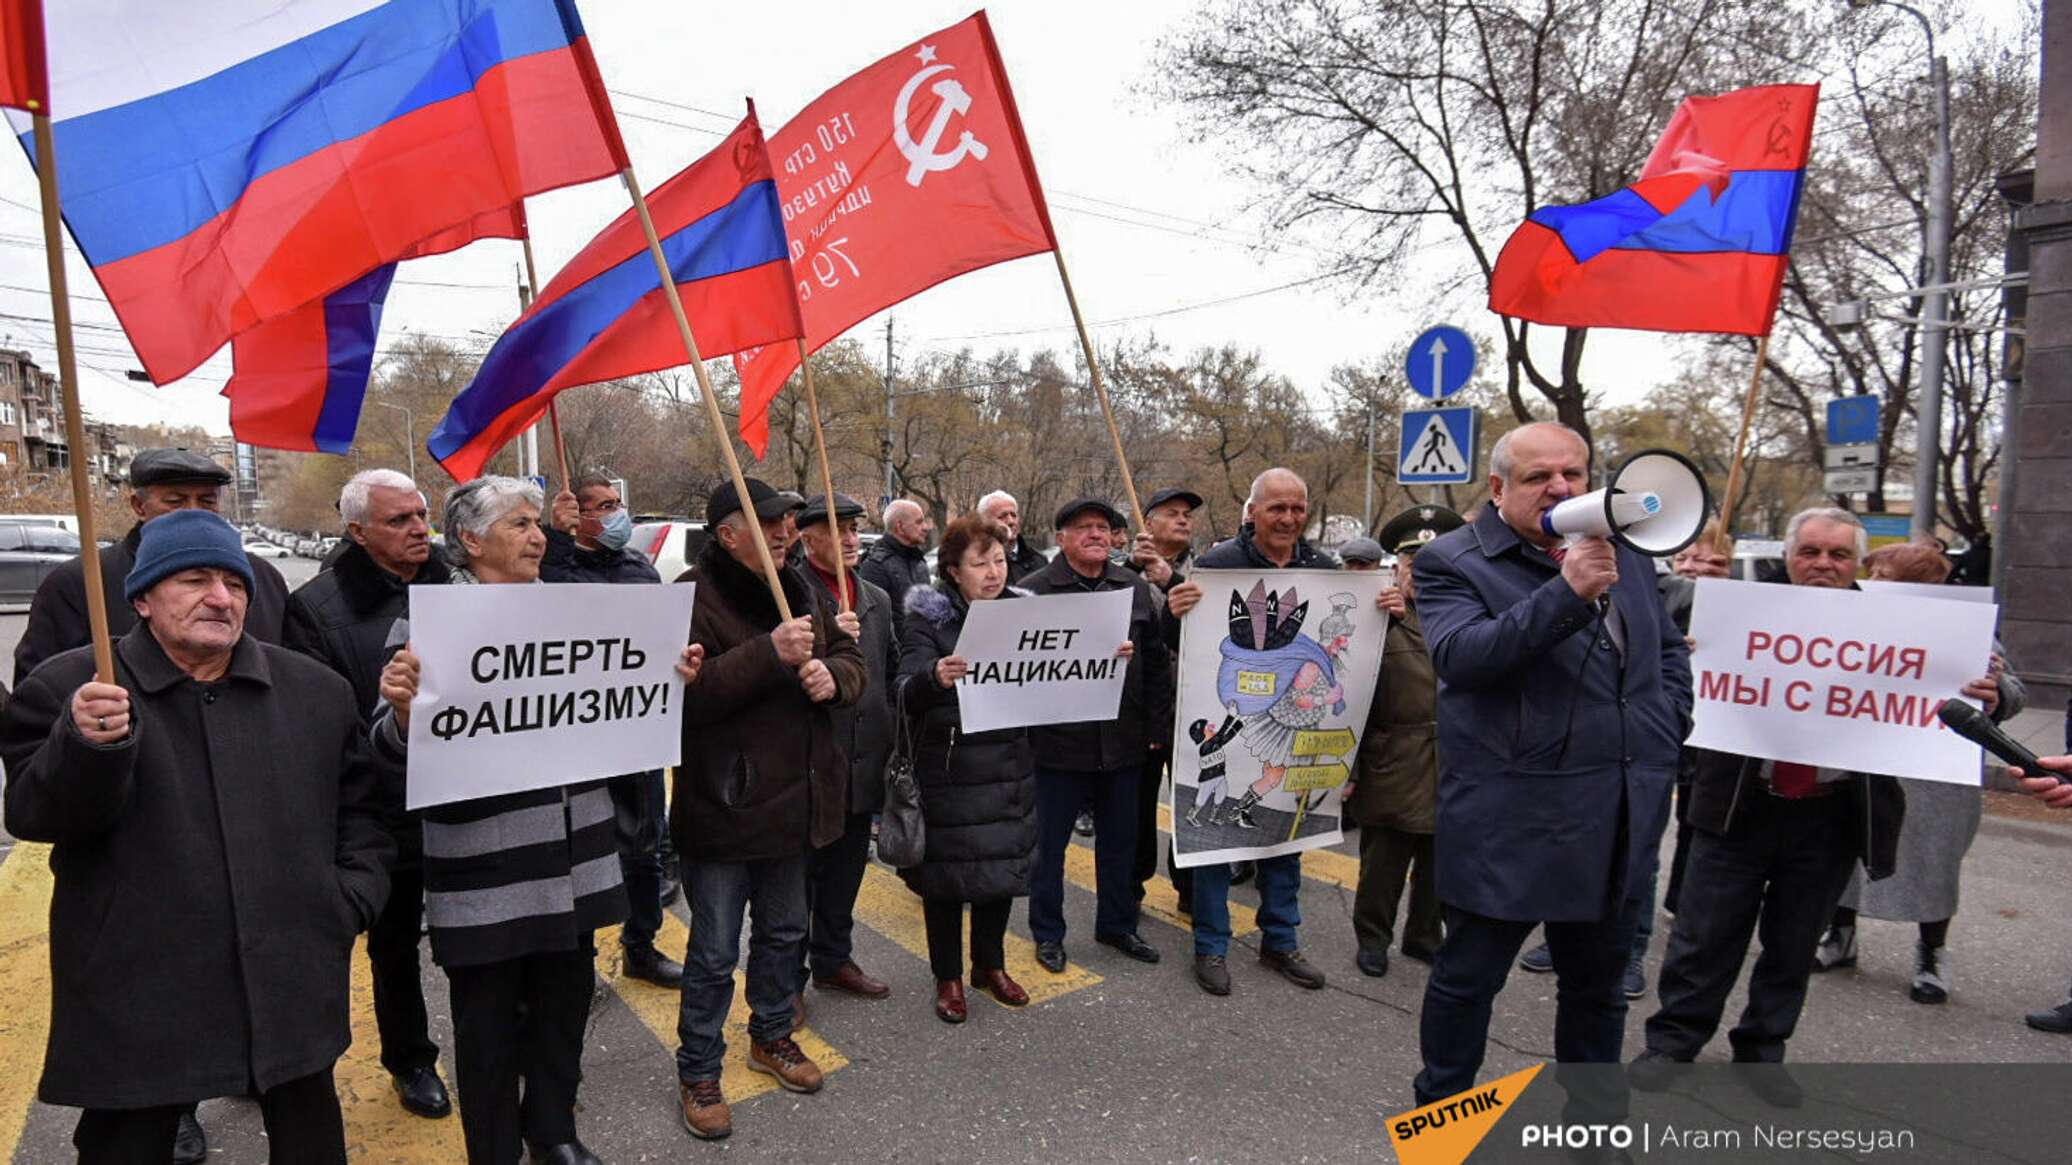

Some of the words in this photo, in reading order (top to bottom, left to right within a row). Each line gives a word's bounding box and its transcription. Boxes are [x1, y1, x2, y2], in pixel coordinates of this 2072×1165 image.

[471, 637, 647, 684] СМЕРТЬ
[1018, 629, 1080, 651] НЕТ
[1746, 631, 1927, 680] РОССИЯ
[963, 658, 1118, 687] НАЦИКАМ!
[1699, 670, 1771, 707] МЫ
[1785, 680, 1813, 712] С
[430, 682, 670, 741] ФАШИЗМУ!
